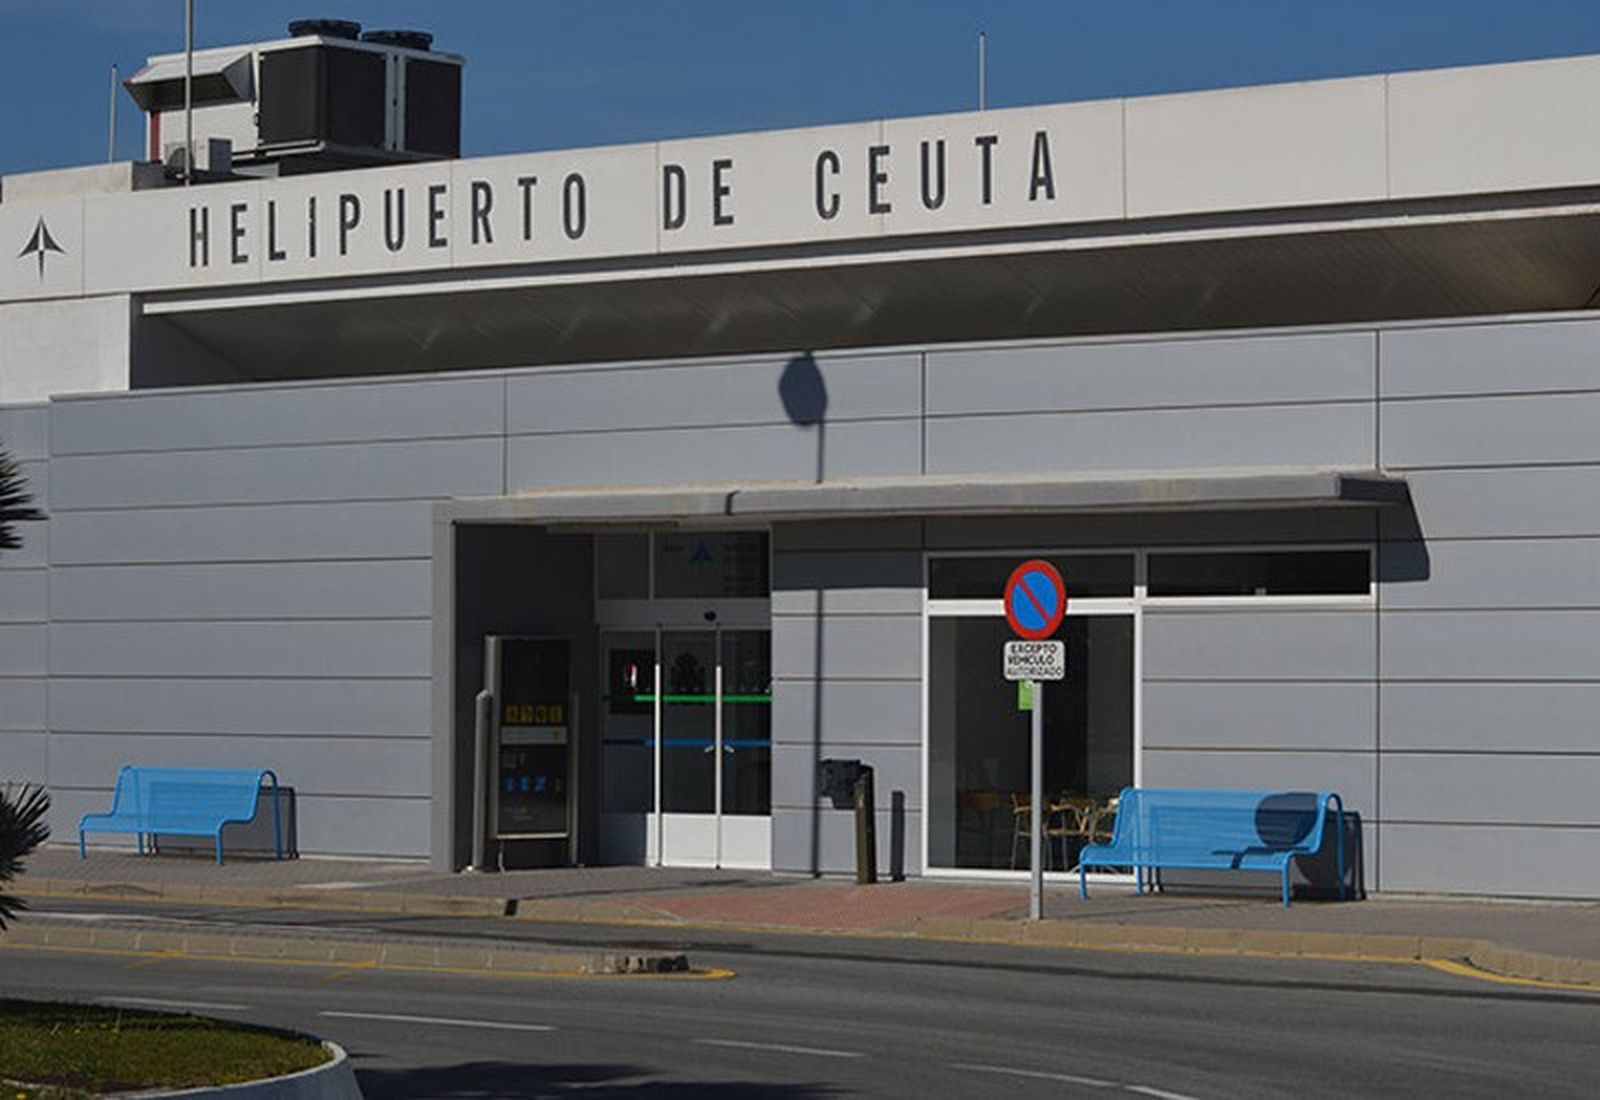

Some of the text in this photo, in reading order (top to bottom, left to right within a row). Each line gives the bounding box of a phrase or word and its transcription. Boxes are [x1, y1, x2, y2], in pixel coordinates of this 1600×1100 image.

[190, 130, 1056, 268] HELIPUERTO DE CEUTA
[1010, 644, 1057, 654] EXCEPTO
[1007, 666, 1062, 676] AUTORIZADO
